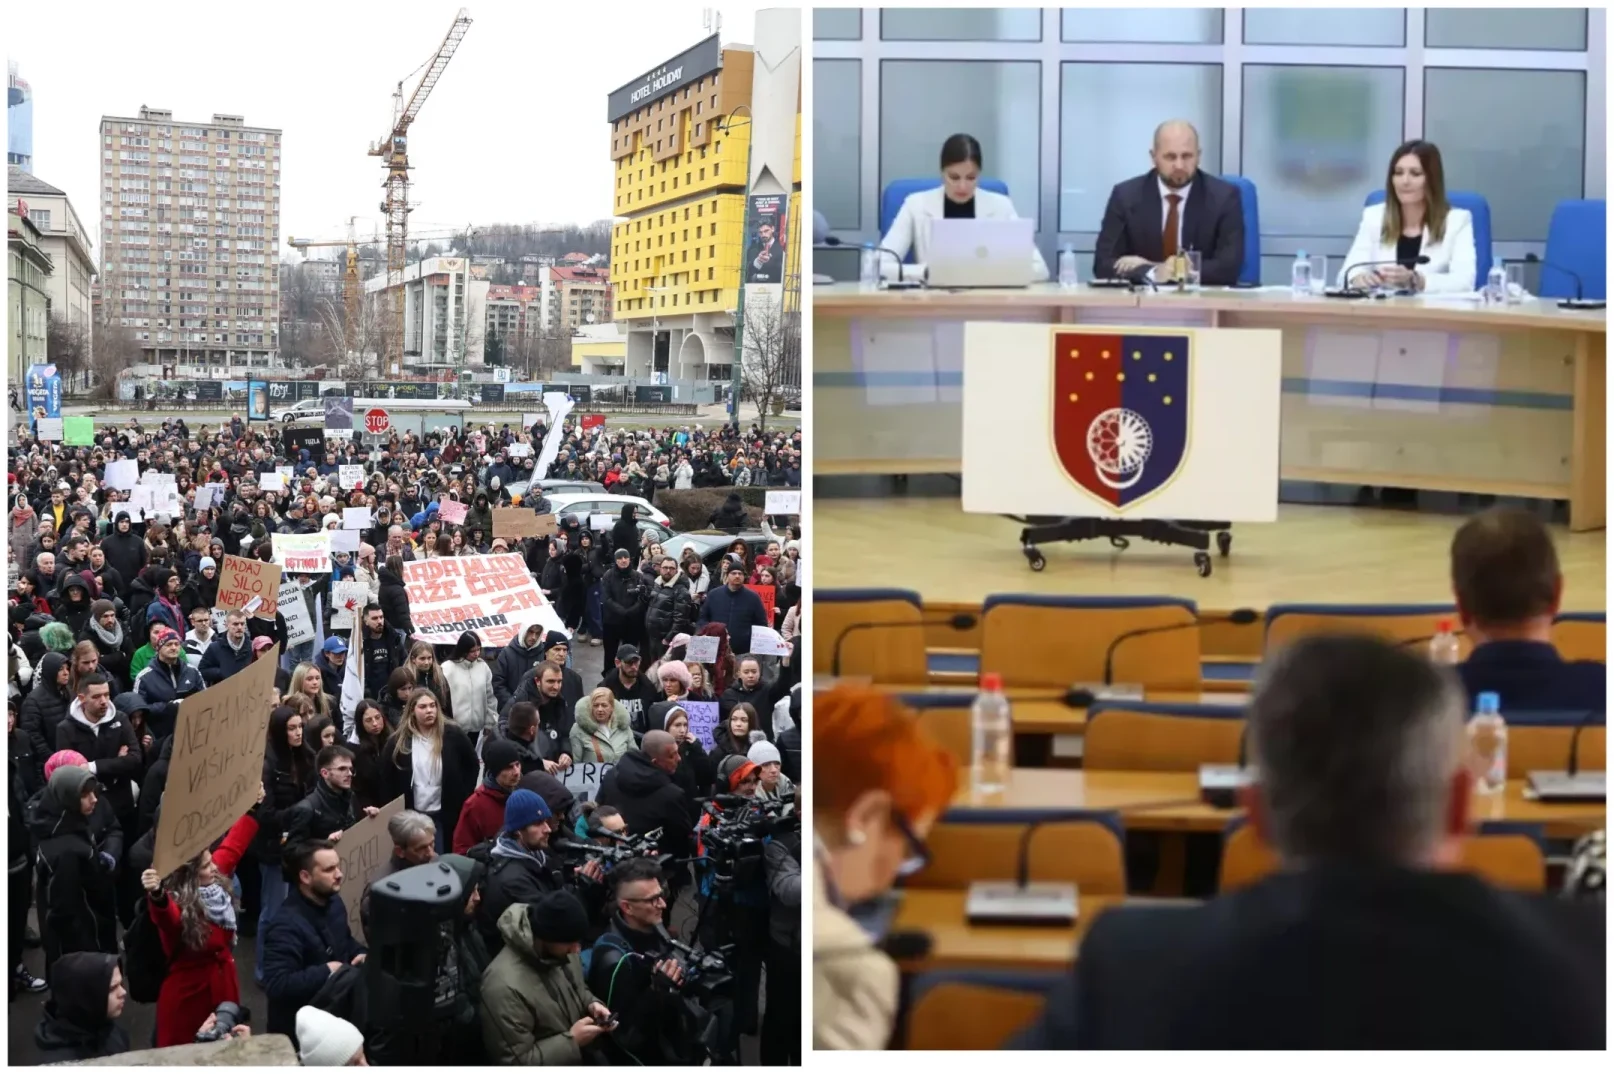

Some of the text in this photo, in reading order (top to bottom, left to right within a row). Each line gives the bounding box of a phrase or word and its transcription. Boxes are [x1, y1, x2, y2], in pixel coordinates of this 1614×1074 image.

[630, 65, 684, 104] HOTEL HOLIDAY
[27, 388, 50, 396] VEGETA
[365, 415, 389, 427] STOP
[224, 557, 262, 576] PADAJ
[232, 574, 263, 593] SILO
[490, 588, 543, 614] ZA
